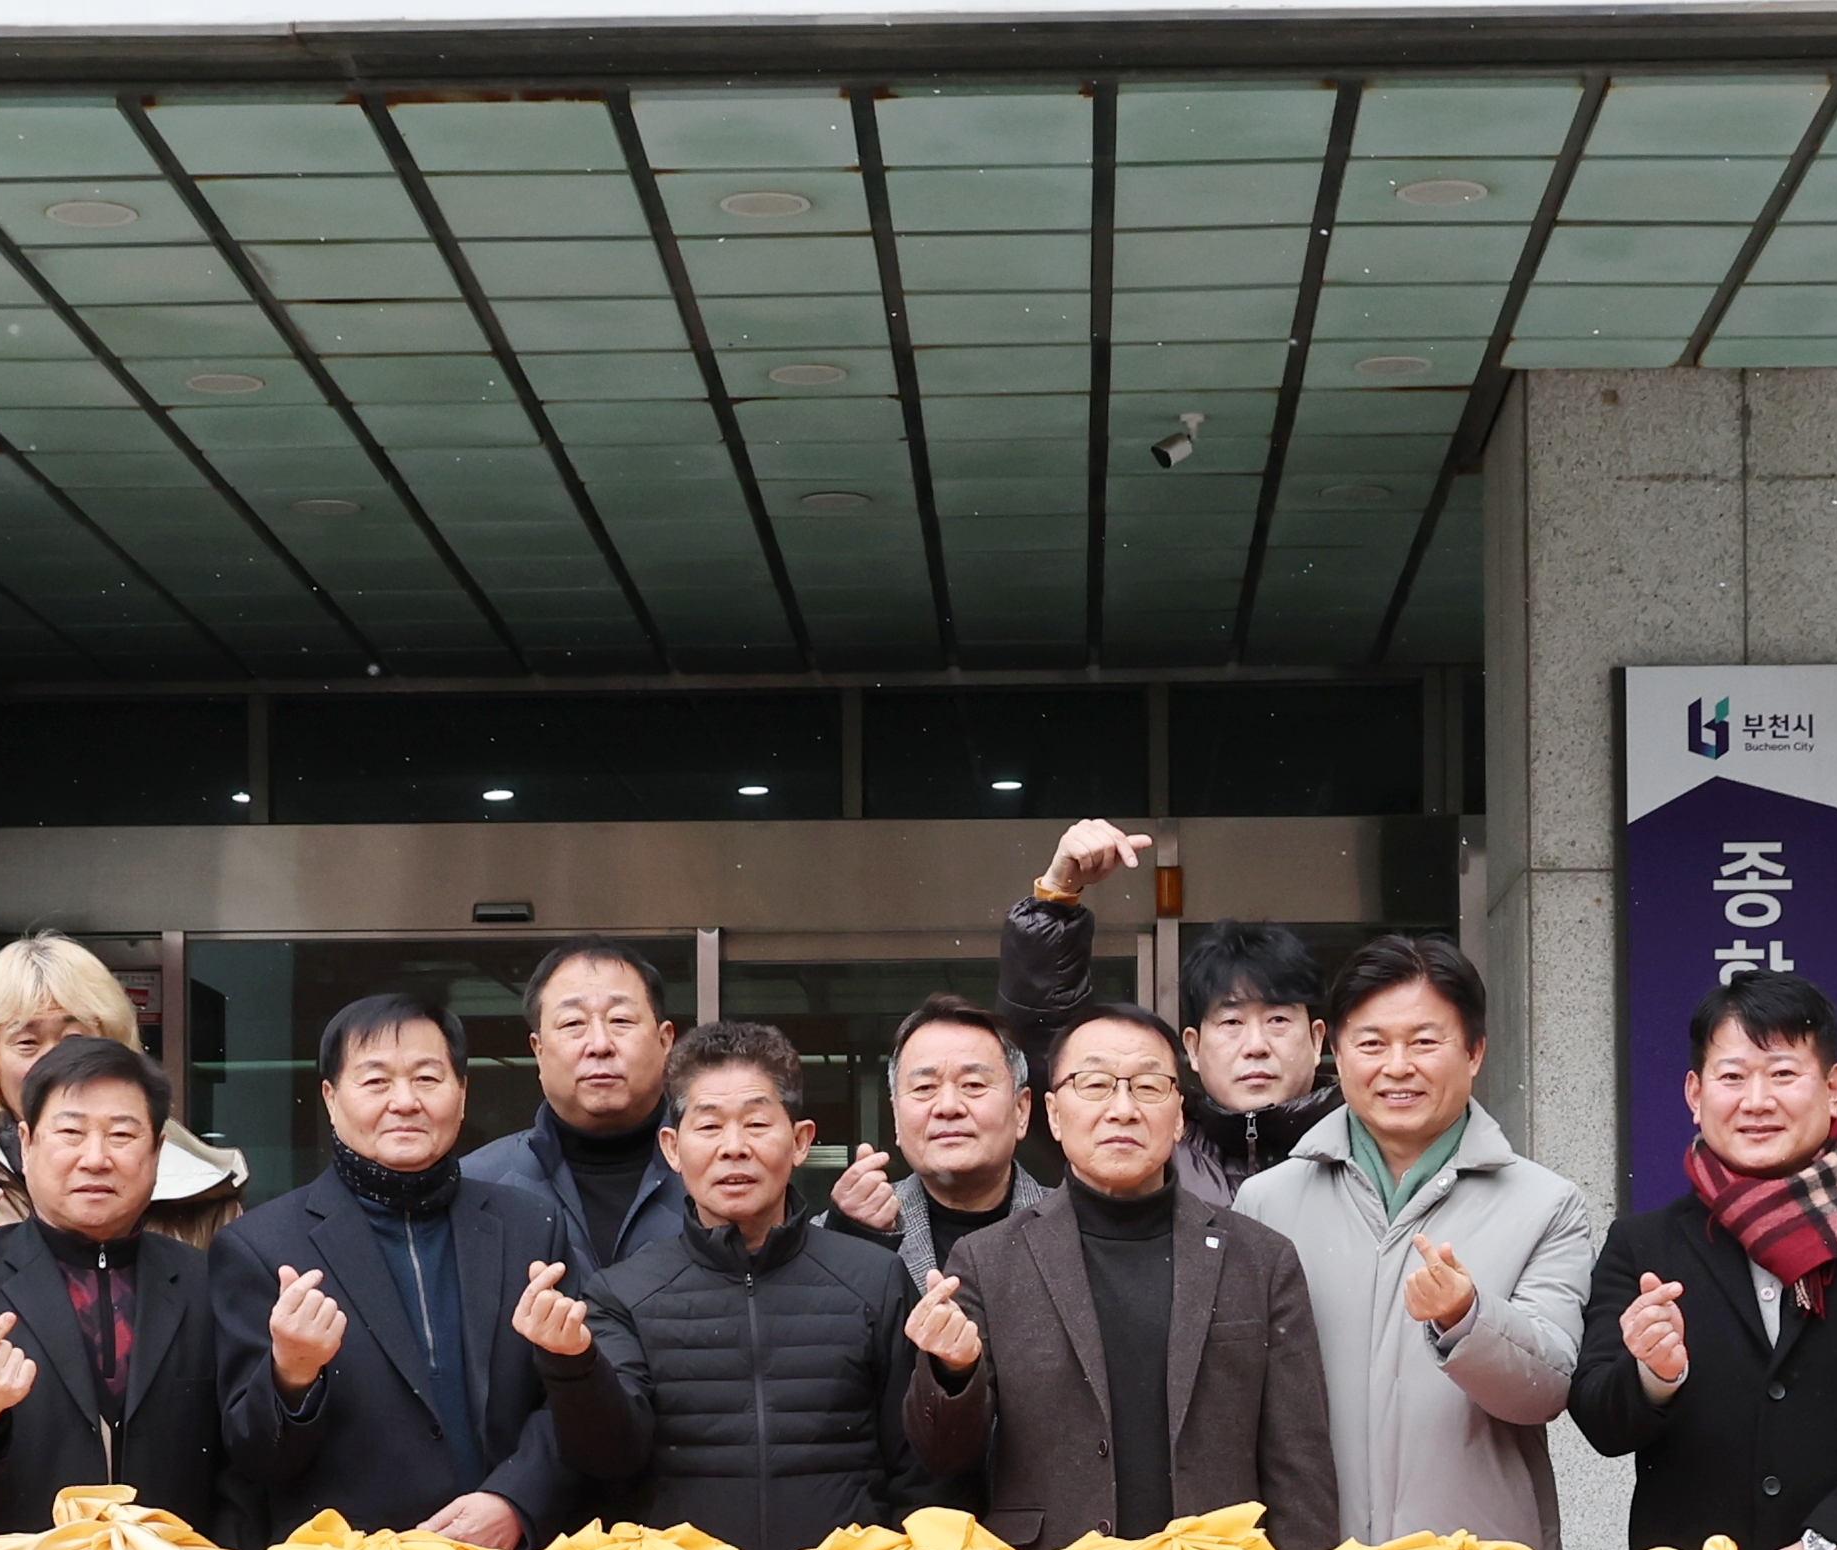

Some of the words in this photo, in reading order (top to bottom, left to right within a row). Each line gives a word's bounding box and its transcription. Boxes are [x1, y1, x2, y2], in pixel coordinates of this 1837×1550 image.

[1742, 713, 1815, 739] 부천시
[1744, 742, 1791, 751] Bucheon
[1793, 742, 1815, 753] City
